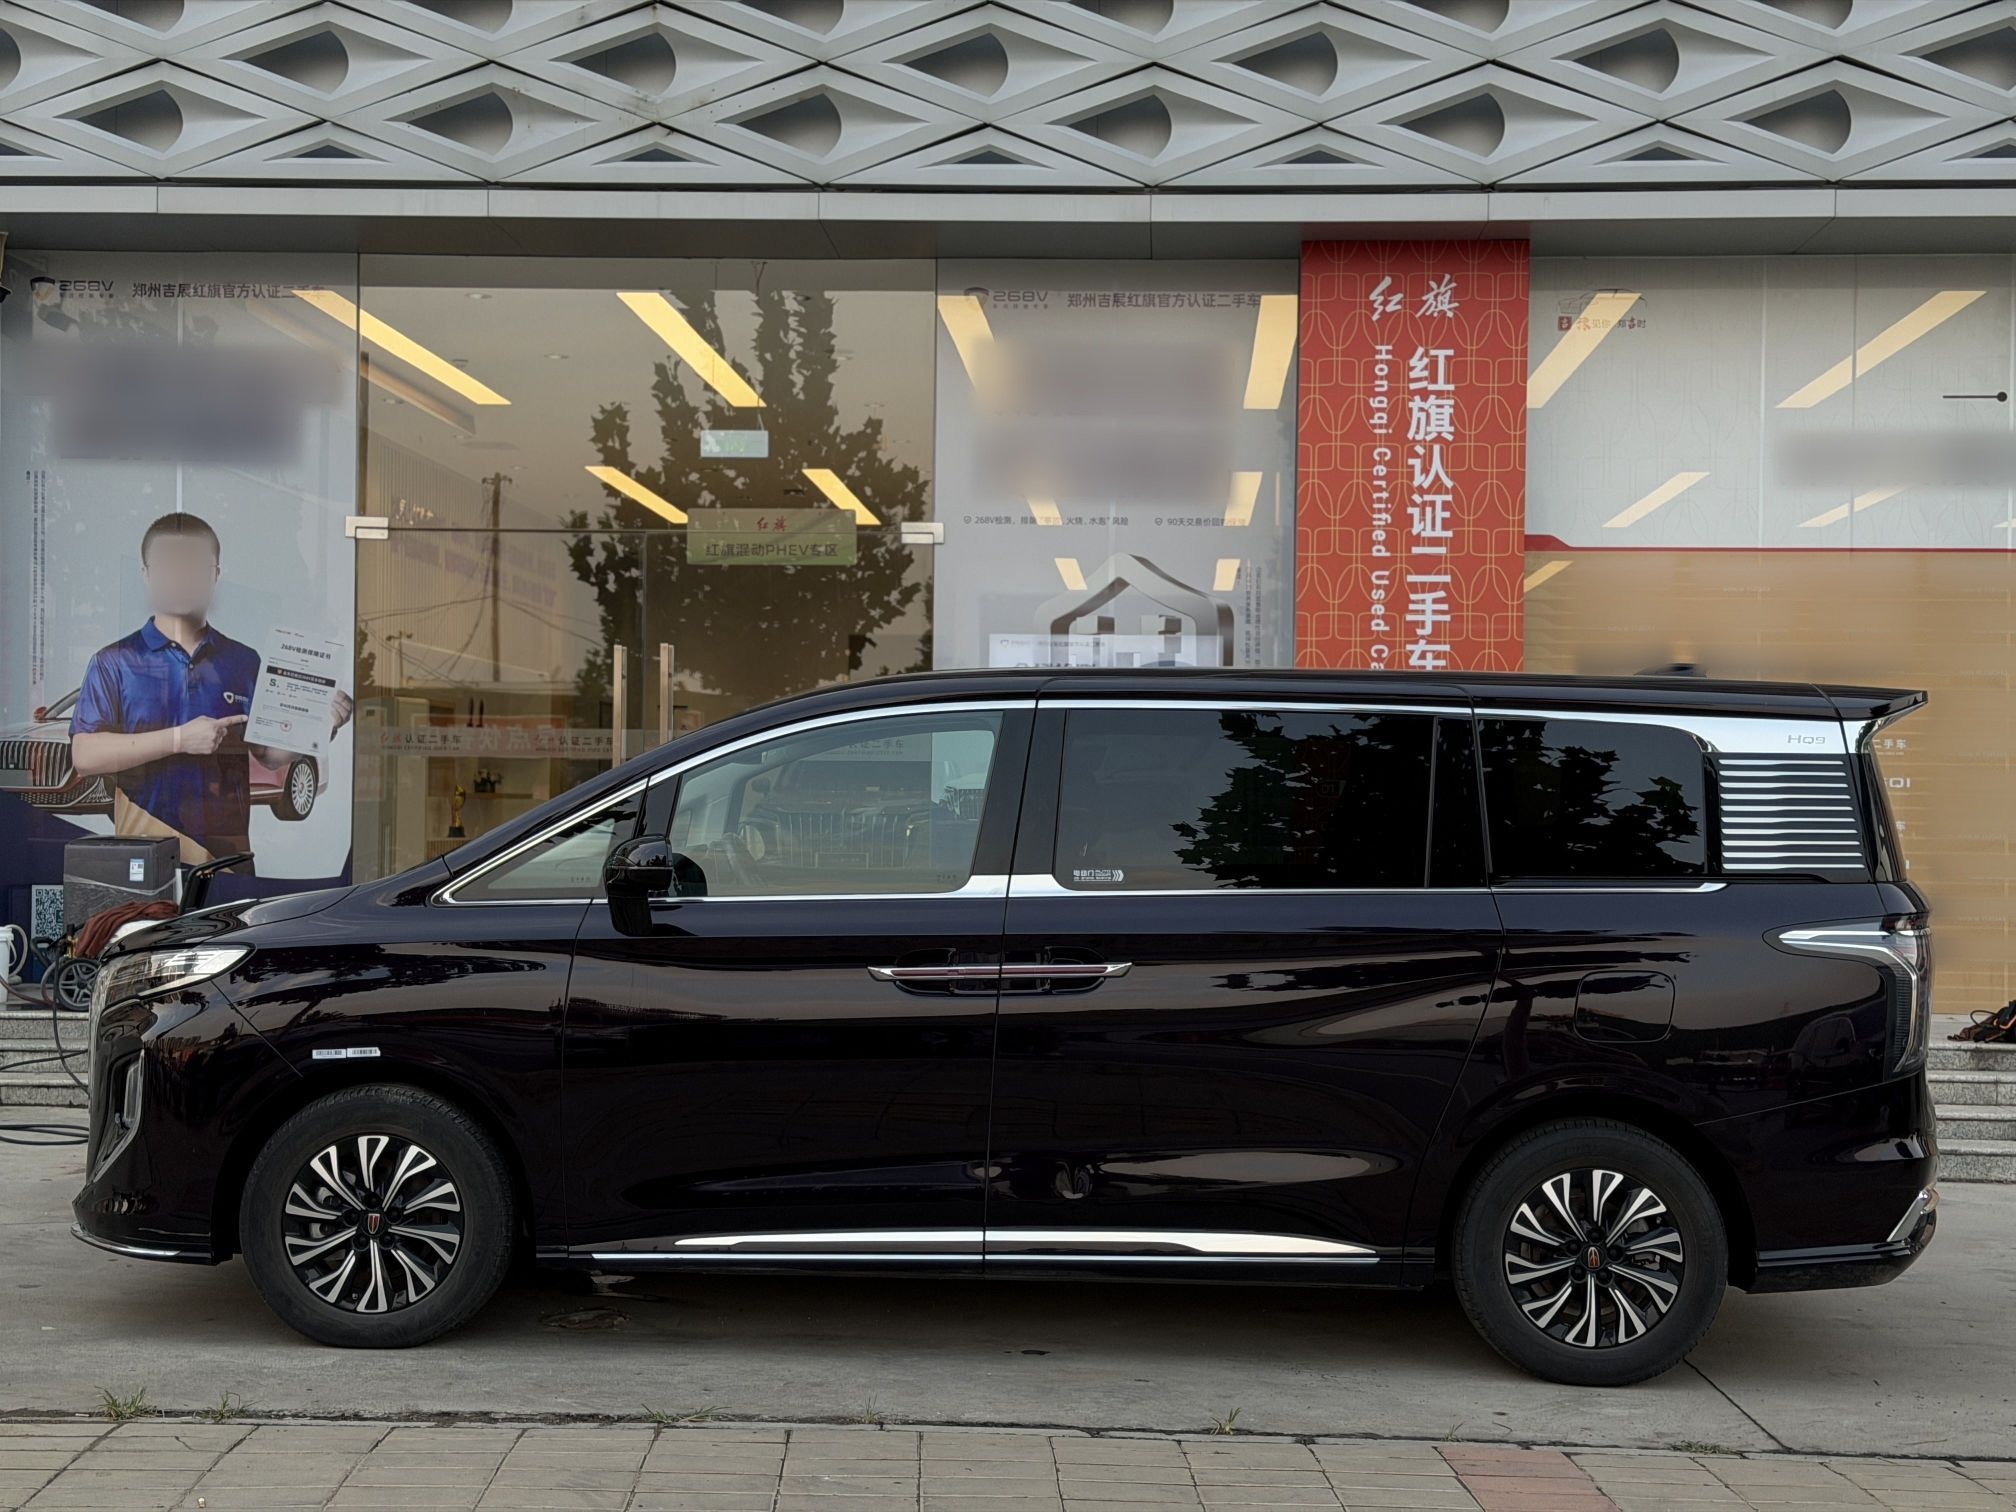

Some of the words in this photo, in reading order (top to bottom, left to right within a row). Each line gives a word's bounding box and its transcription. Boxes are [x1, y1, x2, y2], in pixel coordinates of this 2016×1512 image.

[59, 280, 114, 292] 268V
[993, 291, 1049, 302] 268V
[1369, 274, 1460, 321] 红旗
[1369, 345, 1393, 434] Hongqi
[1372, 447, 1392, 557] Certified
[1405, 346, 1456, 670] 红旗认证二手车
[705, 543, 838, 557] 红旗混动PHEV专区
[1371, 571, 1390, 631] Used
[1787, 734, 1826, 745] HQ9
